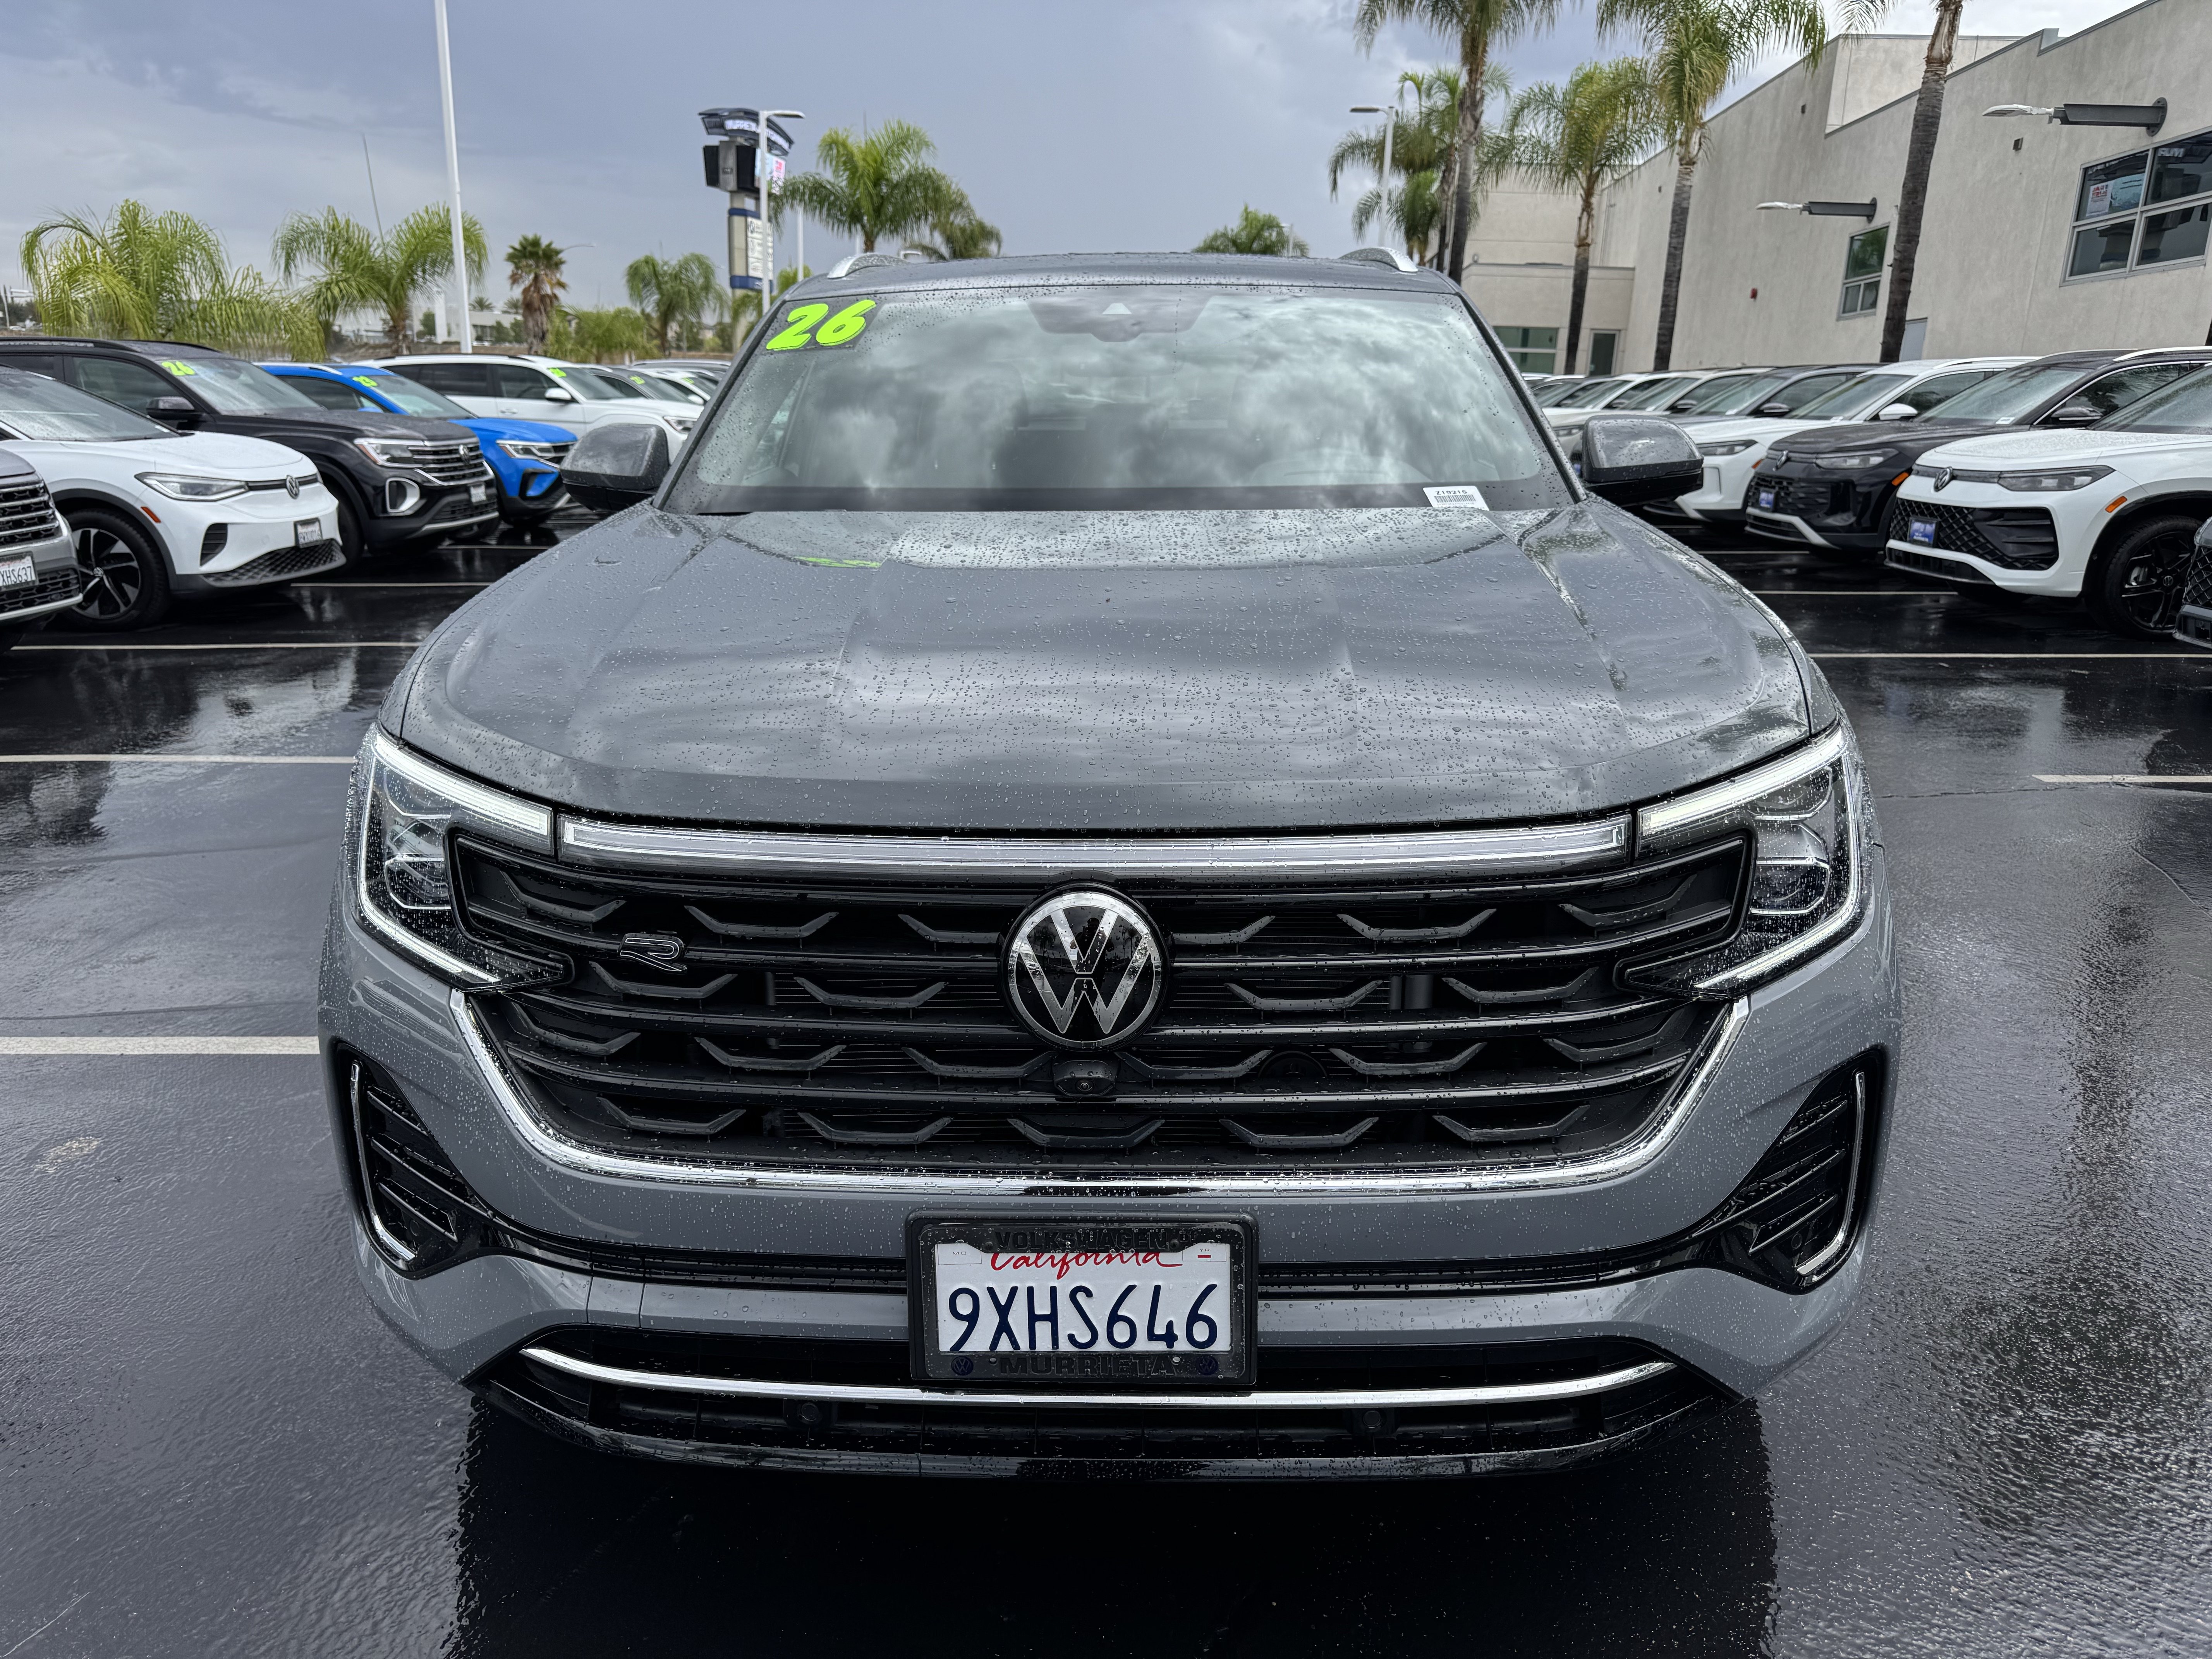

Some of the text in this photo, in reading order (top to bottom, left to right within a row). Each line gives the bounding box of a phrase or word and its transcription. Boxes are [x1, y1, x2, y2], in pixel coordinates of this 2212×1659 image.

[766, 299, 876, 351] 26
[161, 361, 195, 376] 26
[995, 1231, 1169, 1250] VOLKSWAGEN
[948, 1284, 1218, 1351] 9XHS646
[1000, 1356, 1176, 1376] MURRIETA
